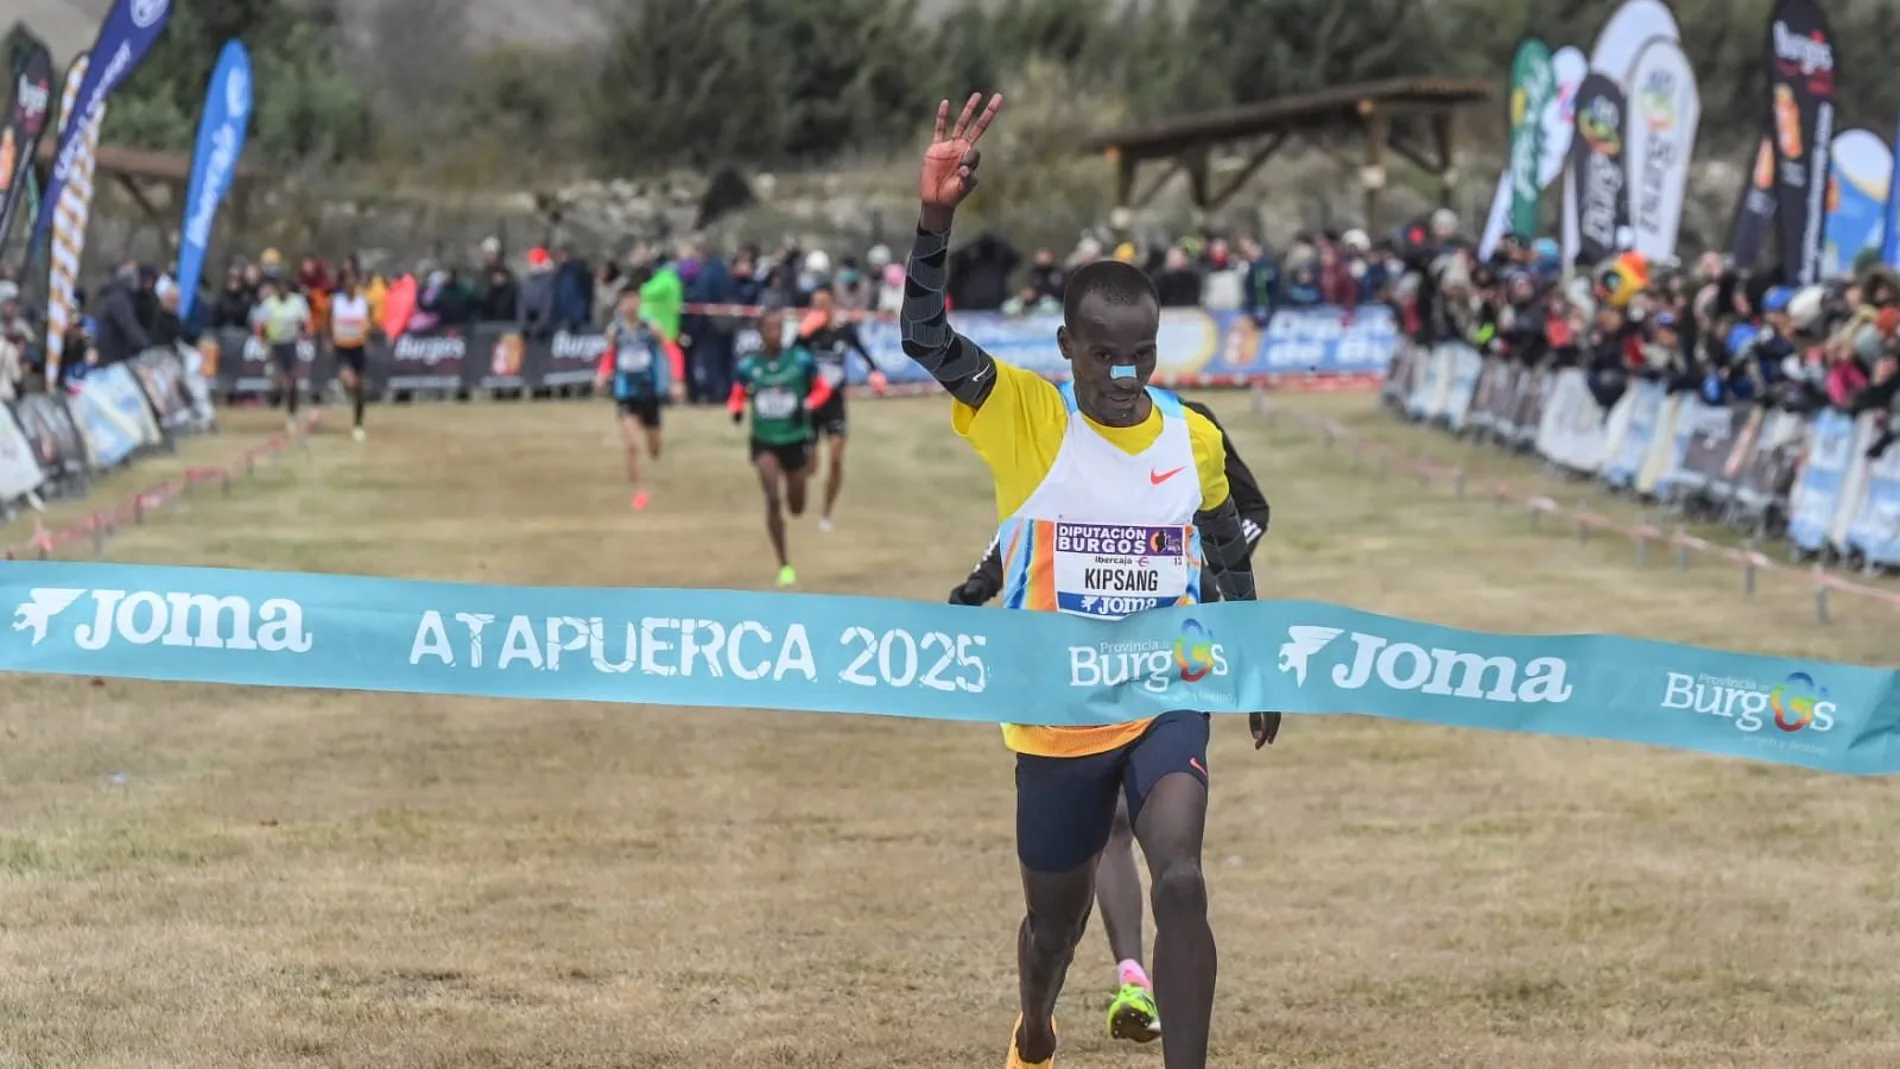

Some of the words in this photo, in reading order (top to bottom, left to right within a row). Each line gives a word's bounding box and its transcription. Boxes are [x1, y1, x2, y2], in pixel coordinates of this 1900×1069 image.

[1058, 526, 1147, 540] DIPUTACIÓN
[1058, 537, 1147, 554] BURGOS
[1095, 555, 1133, 566] Ibercaja
[1084, 568, 1159, 592] KIPSANG
[74, 589, 313, 653] Joma
[409, 610, 819, 685] ATAPUERCA
[838, 626, 991, 693] 2025
[1068, 618, 1229, 692] Burgos
[1100, 640, 1159, 653] Provincia
[1331, 631, 1573, 703] Joma
[1698, 673, 1757, 690] Provincia
[1660, 671, 1837, 733] Burgos
